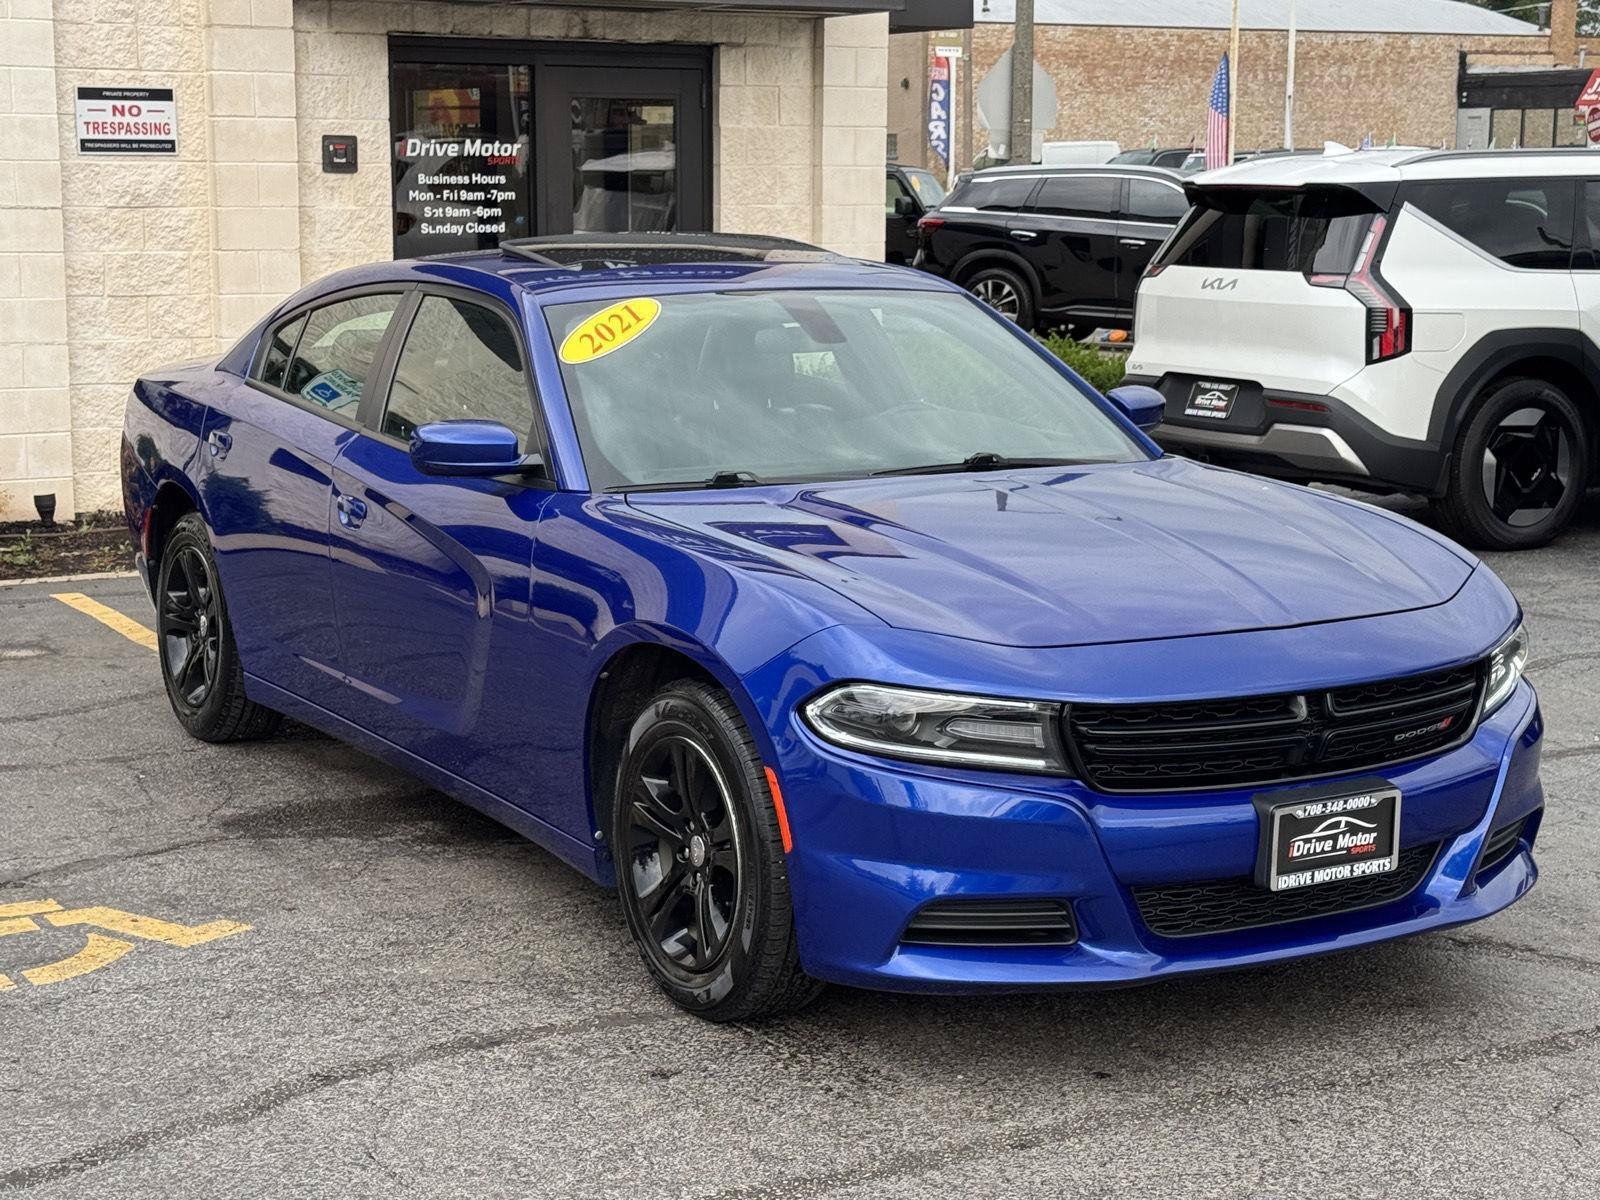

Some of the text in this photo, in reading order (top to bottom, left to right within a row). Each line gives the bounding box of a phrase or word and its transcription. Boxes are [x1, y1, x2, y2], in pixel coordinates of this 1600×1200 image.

[112, 104, 142, 117] NO
[83, 121, 171, 136] TRESPASSING
[463, 139, 521, 157] Motor
[417, 173, 507, 185] Business Hours
[408, 190, 435, 201] Mon
[460, 190, 485, 201] 9am
[445, 206, 470, 217] 9am
[465, 221, 506, 234] Closed
[579, 305, 646, 354] 2021
[1394, 723, 1442, 741] DODGE
[1304, 796, 1370, 815] 708-348-0000
[1288, 832, 1377, 858] iDrive Motor
[1350, 844, 1377, 855] SPORTS
[1313, 866, 1352, 883] MOTOR
[1352, 858, 1391, 876] SPORTS
